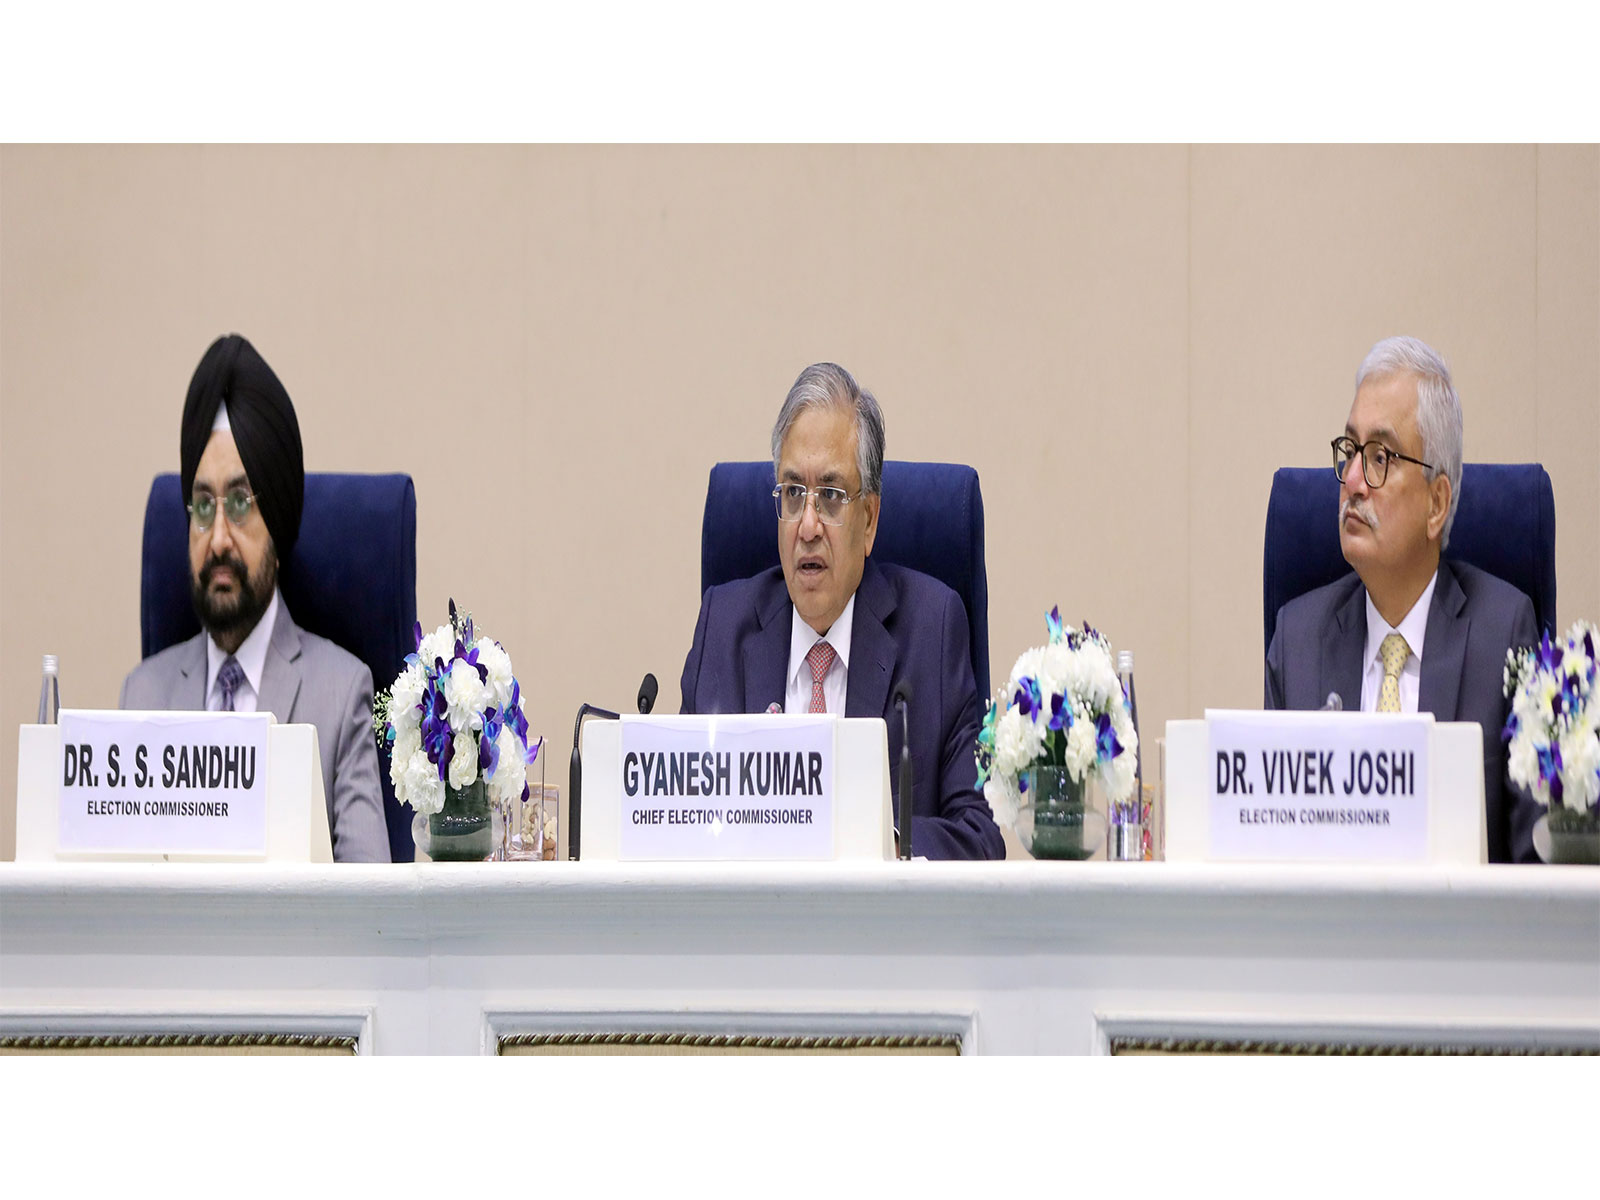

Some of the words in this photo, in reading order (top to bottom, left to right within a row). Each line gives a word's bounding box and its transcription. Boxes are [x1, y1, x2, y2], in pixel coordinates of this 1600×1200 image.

[64, 744, 98, 787] DR.
[107, 744, 126, 787] S.
[135, 744, 153, 788] S.
[162, 745, 255, 789] SANDHU
[624, 752, 730, 796] GYANESH
[740, 752, 822, 796] KUMAR
[1217, 751, 1253, 794] DR.
[1262, 751, 1334, 794] VIVEK
[1343, 751, 1414, 795] JOSHI
[88, 801, 140, 815] ELECTION
[144, 802, 228, 816] COMMISSIONER
[633, 810, 664, 824] CHIEF
[669, 810, 722, 824] ELECTION
[727, 810, 812, 824] COMMISSIONER
[1240, 810, 1295, 823] ELECTION
[1300, 810, 1389, 824] COMMISSIONER
